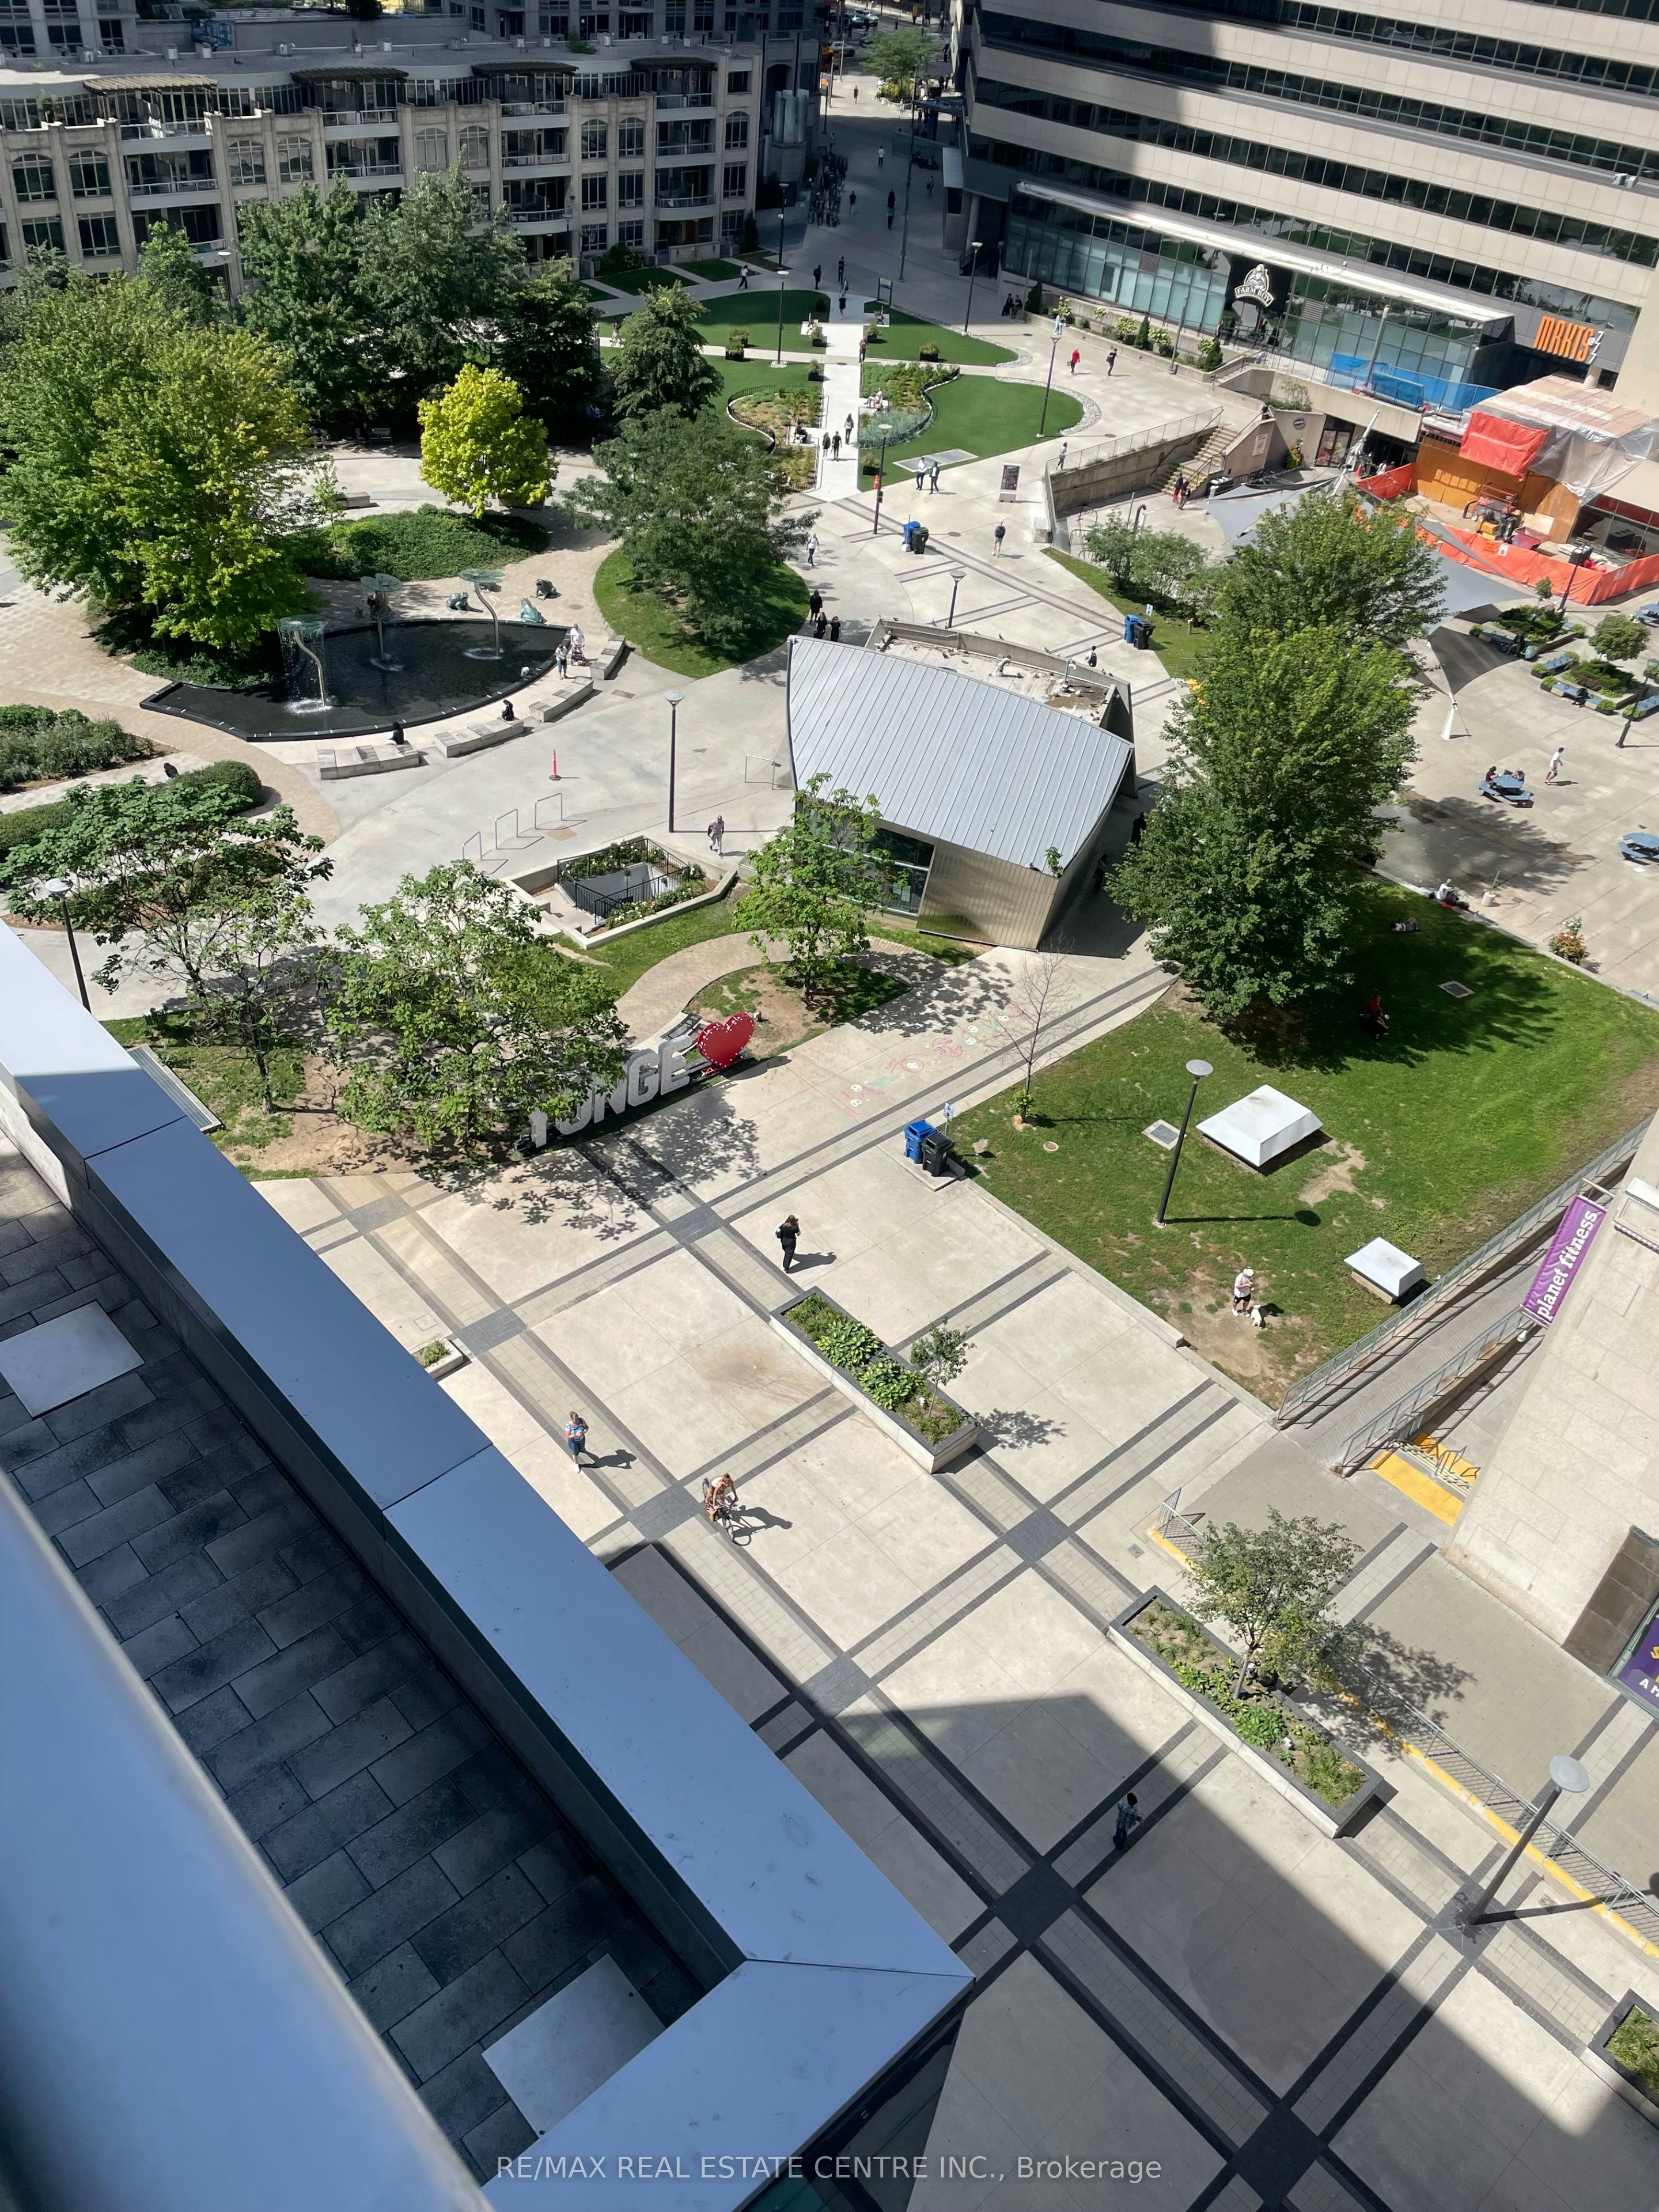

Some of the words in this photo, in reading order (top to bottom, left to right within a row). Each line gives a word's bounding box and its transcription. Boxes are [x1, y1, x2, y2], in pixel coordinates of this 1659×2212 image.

[1237, 287, 1256, 295] FARM
[1257, 289, 1271, 302] BOY
[1536, 1267, 1569, 1321] planet
[1559, 1210, 1598, 1269] fitness
